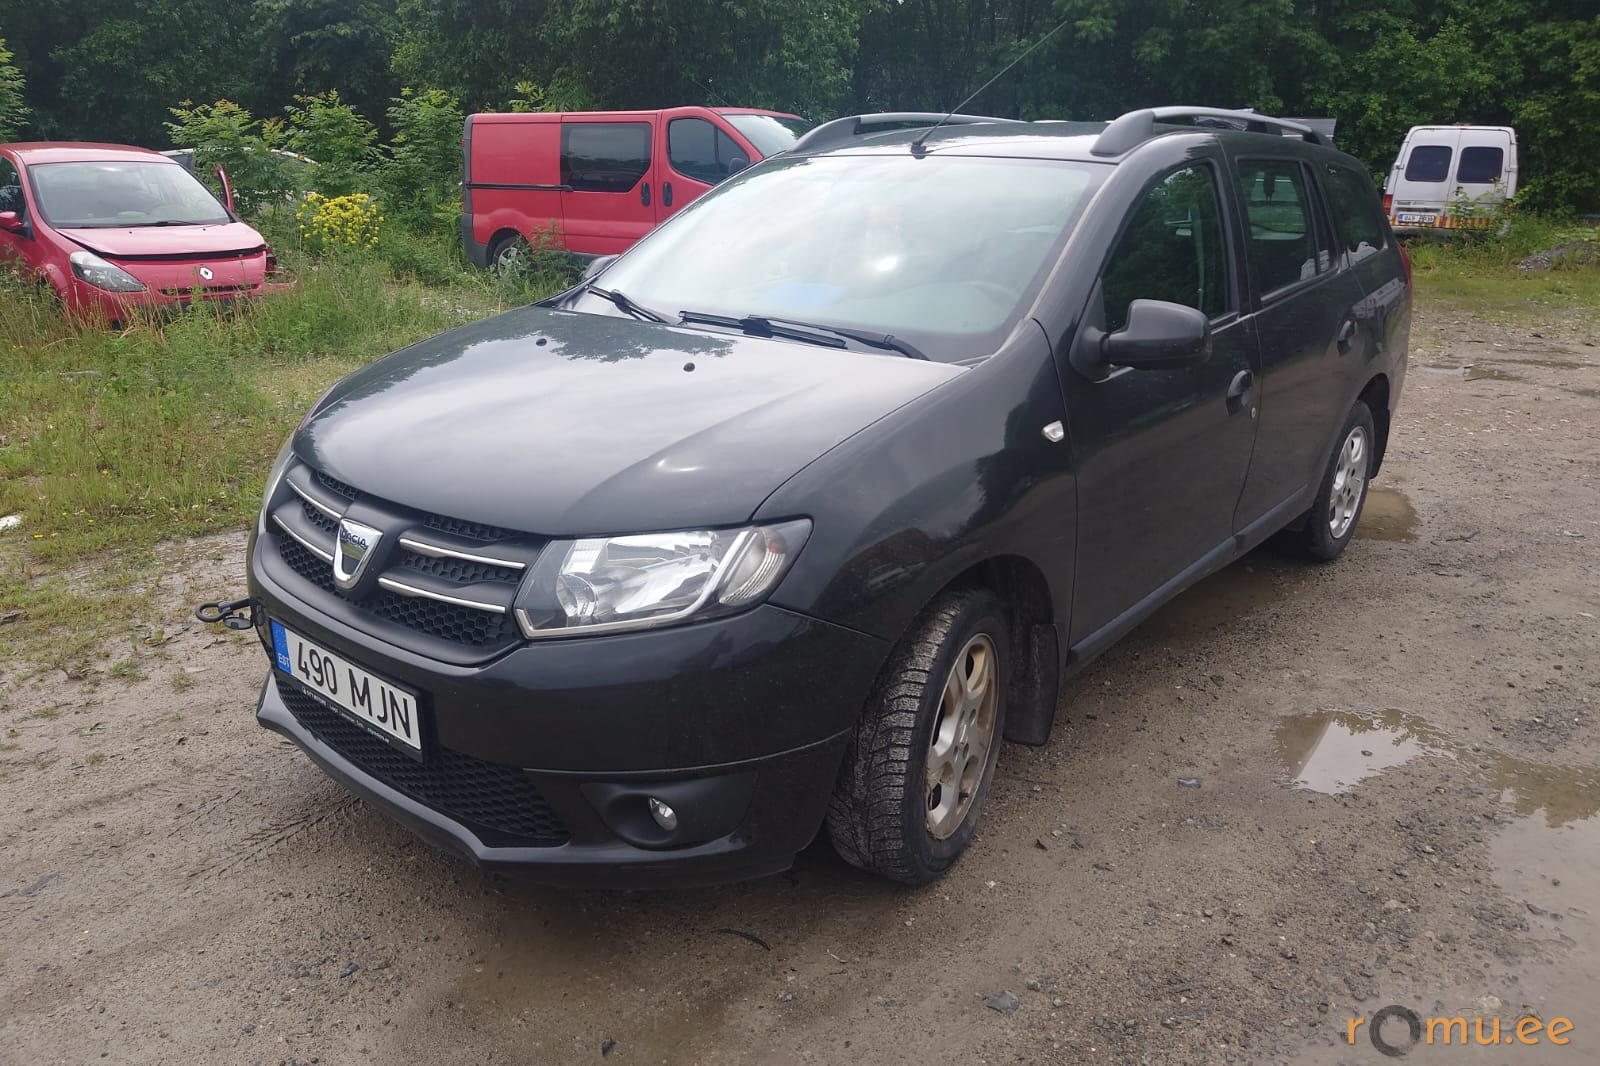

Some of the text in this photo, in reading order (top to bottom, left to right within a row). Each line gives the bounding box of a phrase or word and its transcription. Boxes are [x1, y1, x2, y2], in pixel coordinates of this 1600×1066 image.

[341, 530, 367, 547] DACIA
[278, 652, 290, 667] EST
[298, 642, 338, 695] 490
[348, 668, 412, 739] MJN
